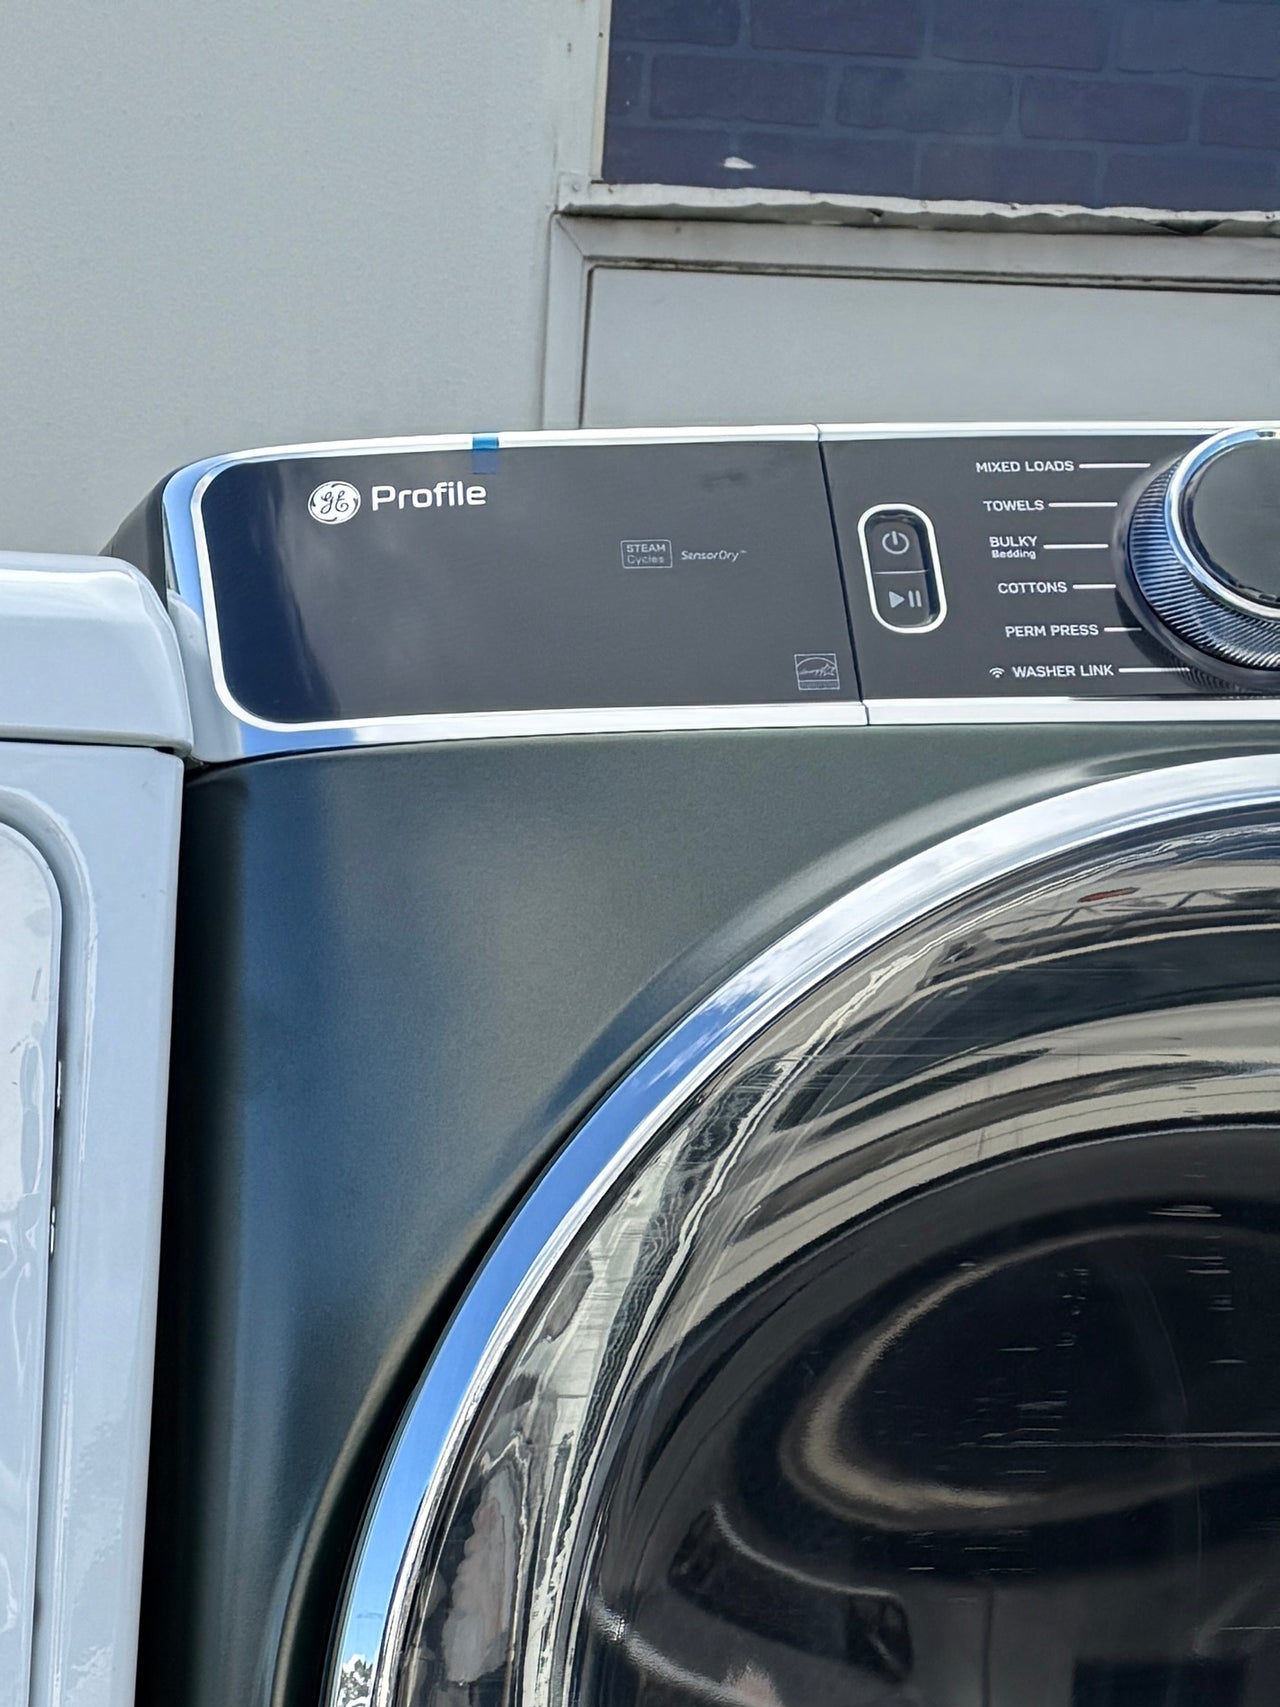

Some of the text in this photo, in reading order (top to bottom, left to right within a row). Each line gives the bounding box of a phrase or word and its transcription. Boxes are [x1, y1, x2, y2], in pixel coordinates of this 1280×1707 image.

[976, 460, 1075, 473] MIXED LOADS
[371, 480, 487, 512] Profile
[983, 499, 1045, 512] TOWELS
[989, 536, 1038, 548] BULKY
[626, 544, 666, 554] STEAM
[991, 549, 1036, 560] Bedding
[627, 554, 665, 566] Cycles
[997, 581, 1068, 594] COTTONS
[1005, 624, 1099, 638] PERM PRESS
[1012, 664, 1115, 678] WASHER LINK
